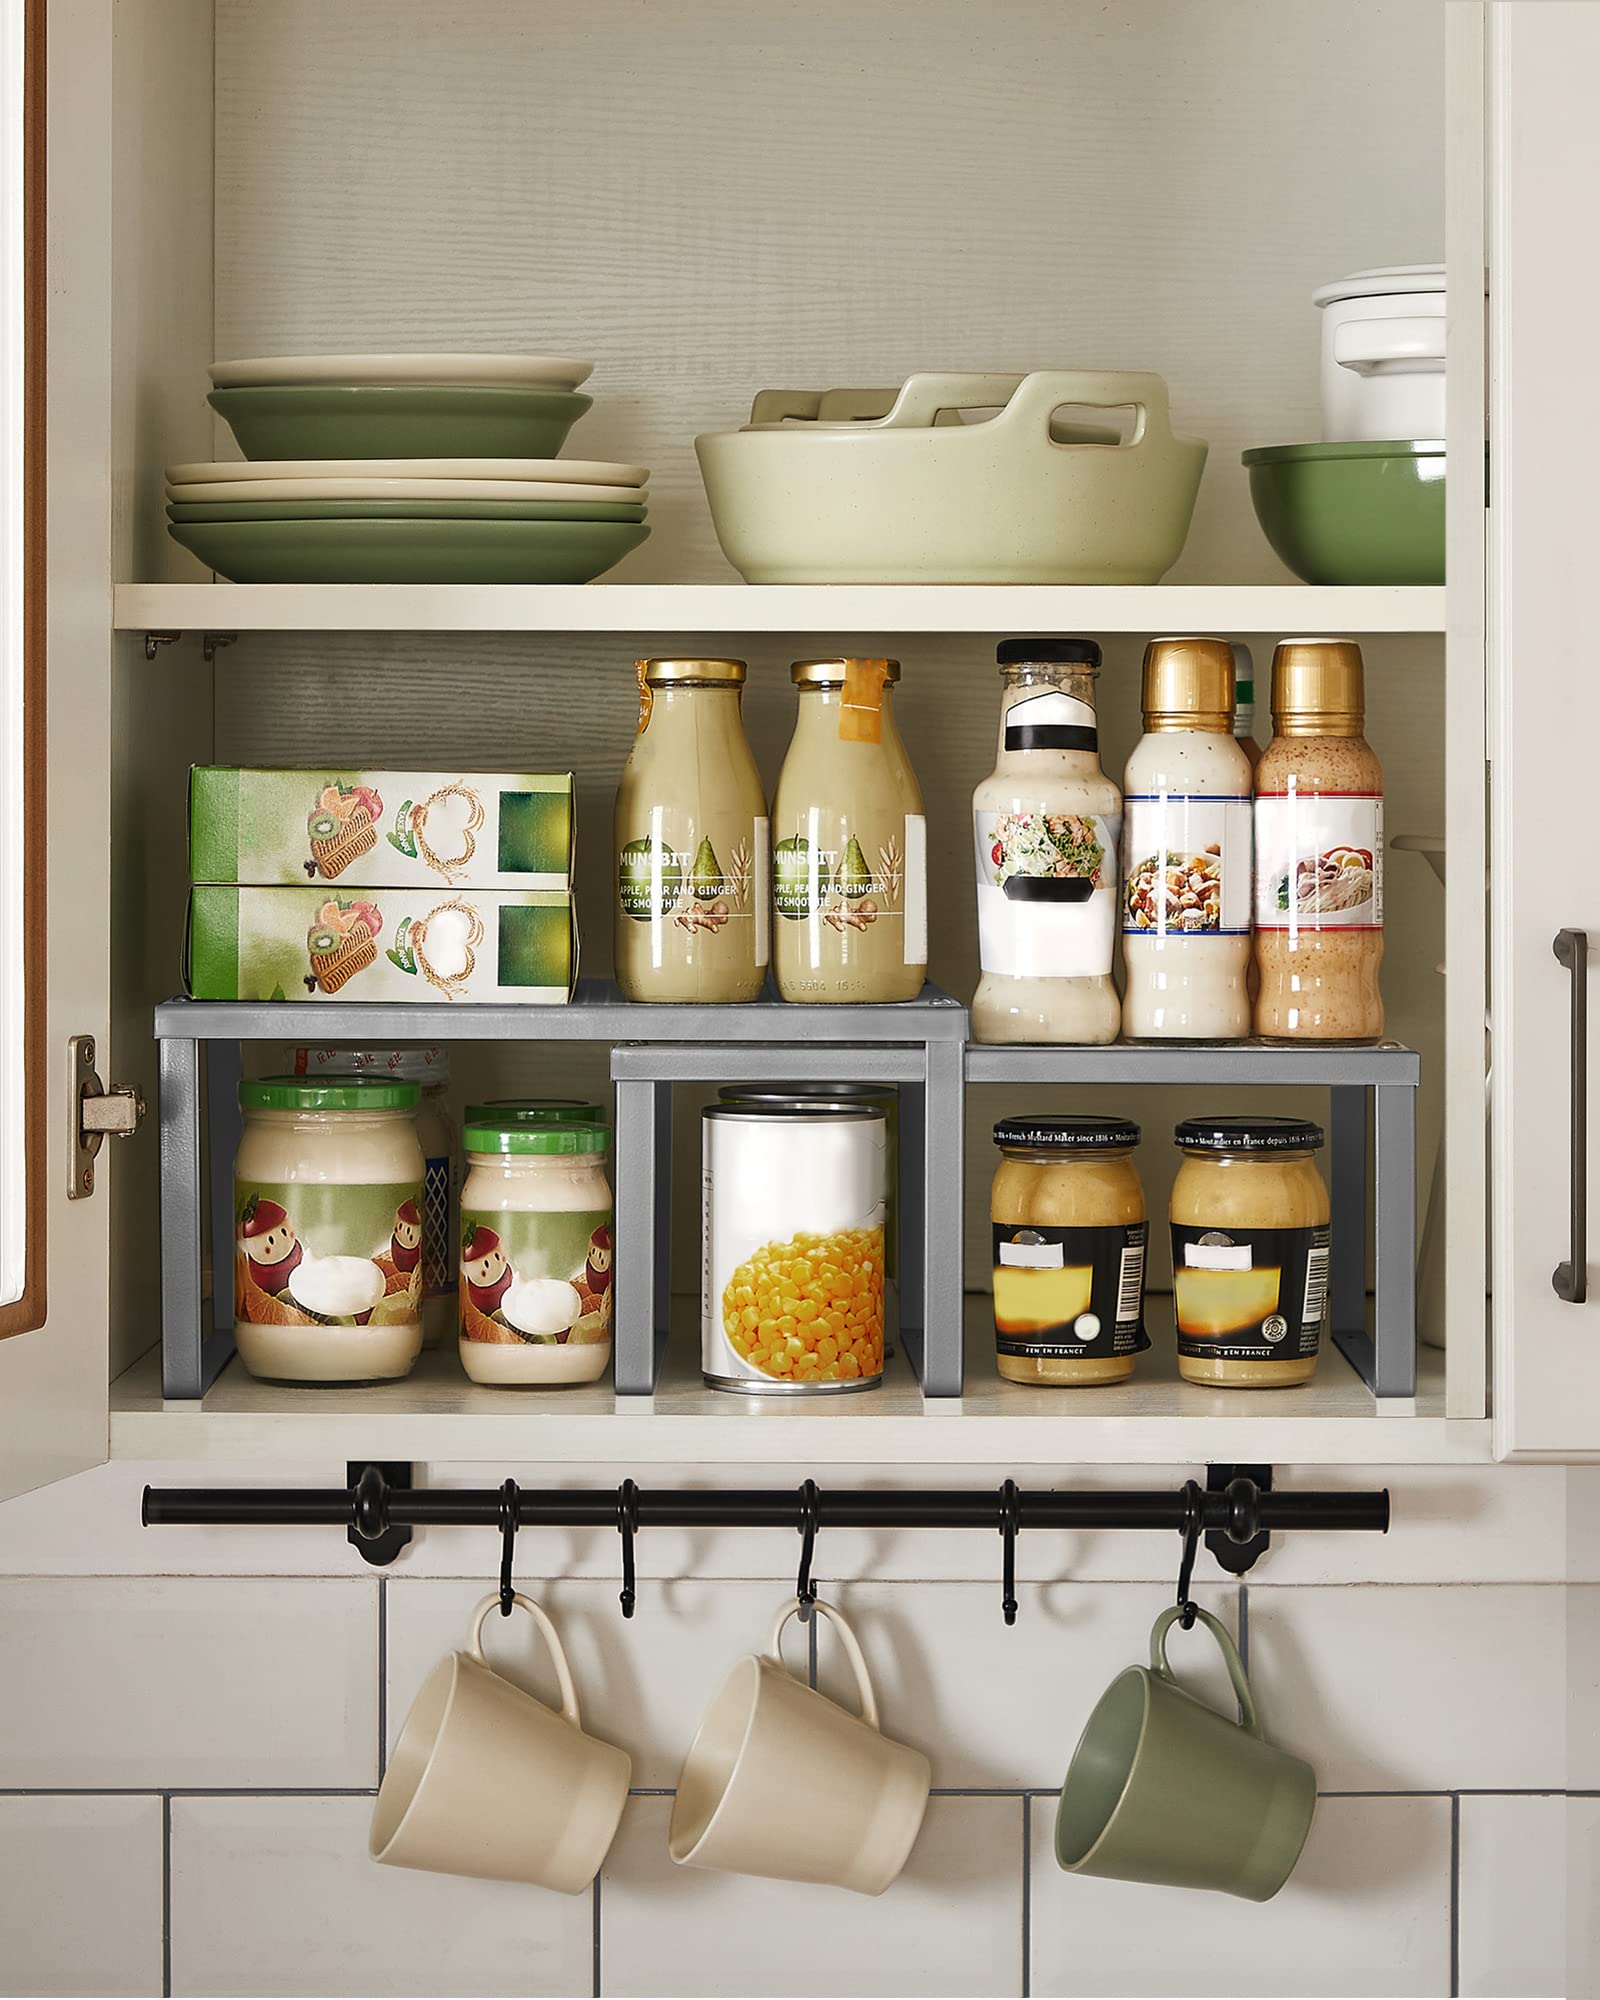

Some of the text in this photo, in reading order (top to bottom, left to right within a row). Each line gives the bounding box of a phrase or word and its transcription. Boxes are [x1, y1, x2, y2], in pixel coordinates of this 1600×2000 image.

[398, 832, 412, 852] AWAY
[774, 850, 838, 865] MUNSIT
[672, 885, 695, 895] AND
[698, 885, 737, 895] GINGER
[820, 884, 842, 893] AND
[846, 884, 885, 894] GINGER
[633, 899, 683, 909] SMOTHIE
[398, 949, 412, 969] AWAY
[1027, 1132, 1053, 1141] Mustard
[1054, 1133, 1075, 1142] Maker
[1076, 1134, 1094, 1142] since
[1095, 1133, 1109, 1142] 1816
[1243, 1136, 1265, 1145] France
[1266, 1136, 1288, 1146] depuis
[1054, 1347, 1084, 1355] FRANCE
